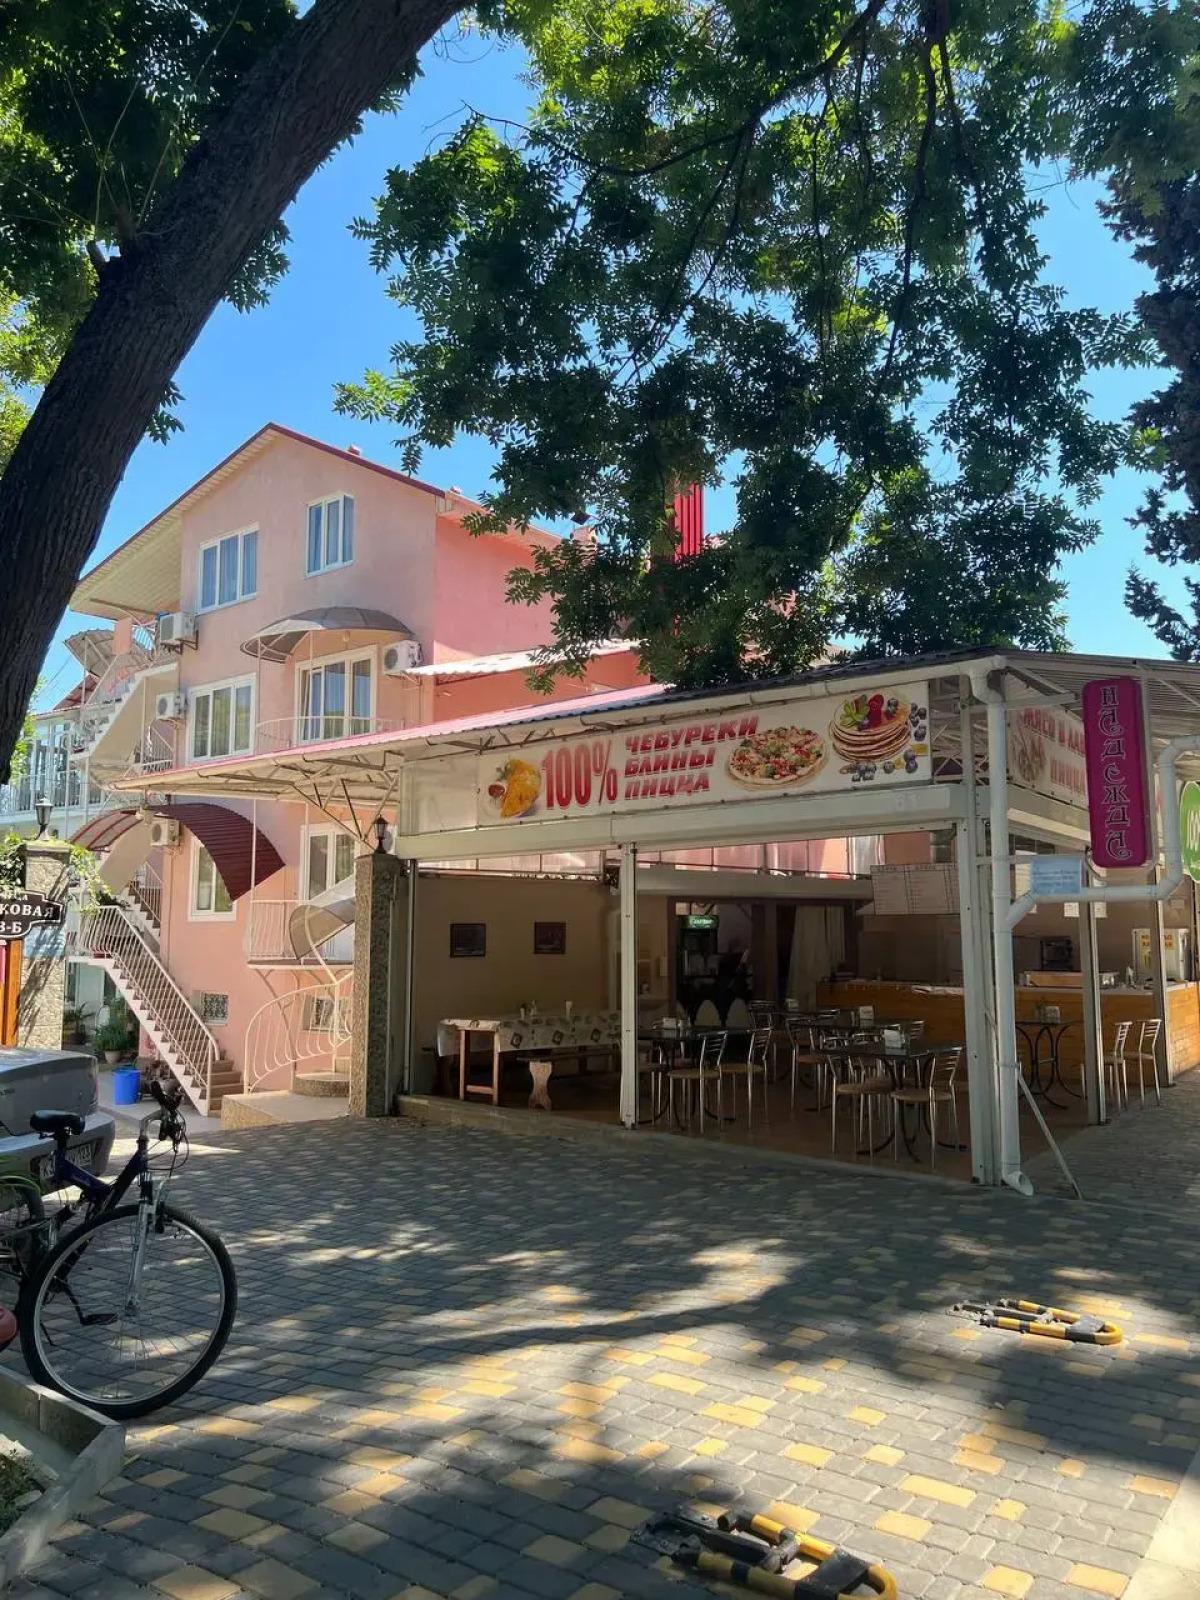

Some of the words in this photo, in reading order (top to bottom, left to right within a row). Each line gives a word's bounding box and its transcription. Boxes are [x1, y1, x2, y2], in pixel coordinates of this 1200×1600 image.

[625, 715, 760, 755] ЧЕБУРЕКИ
[541, 739, 619, 811] 100%
[625, 747, 717, 778] БЛИНЫ
[625, 772, 711, 800] ПИЦЦА
